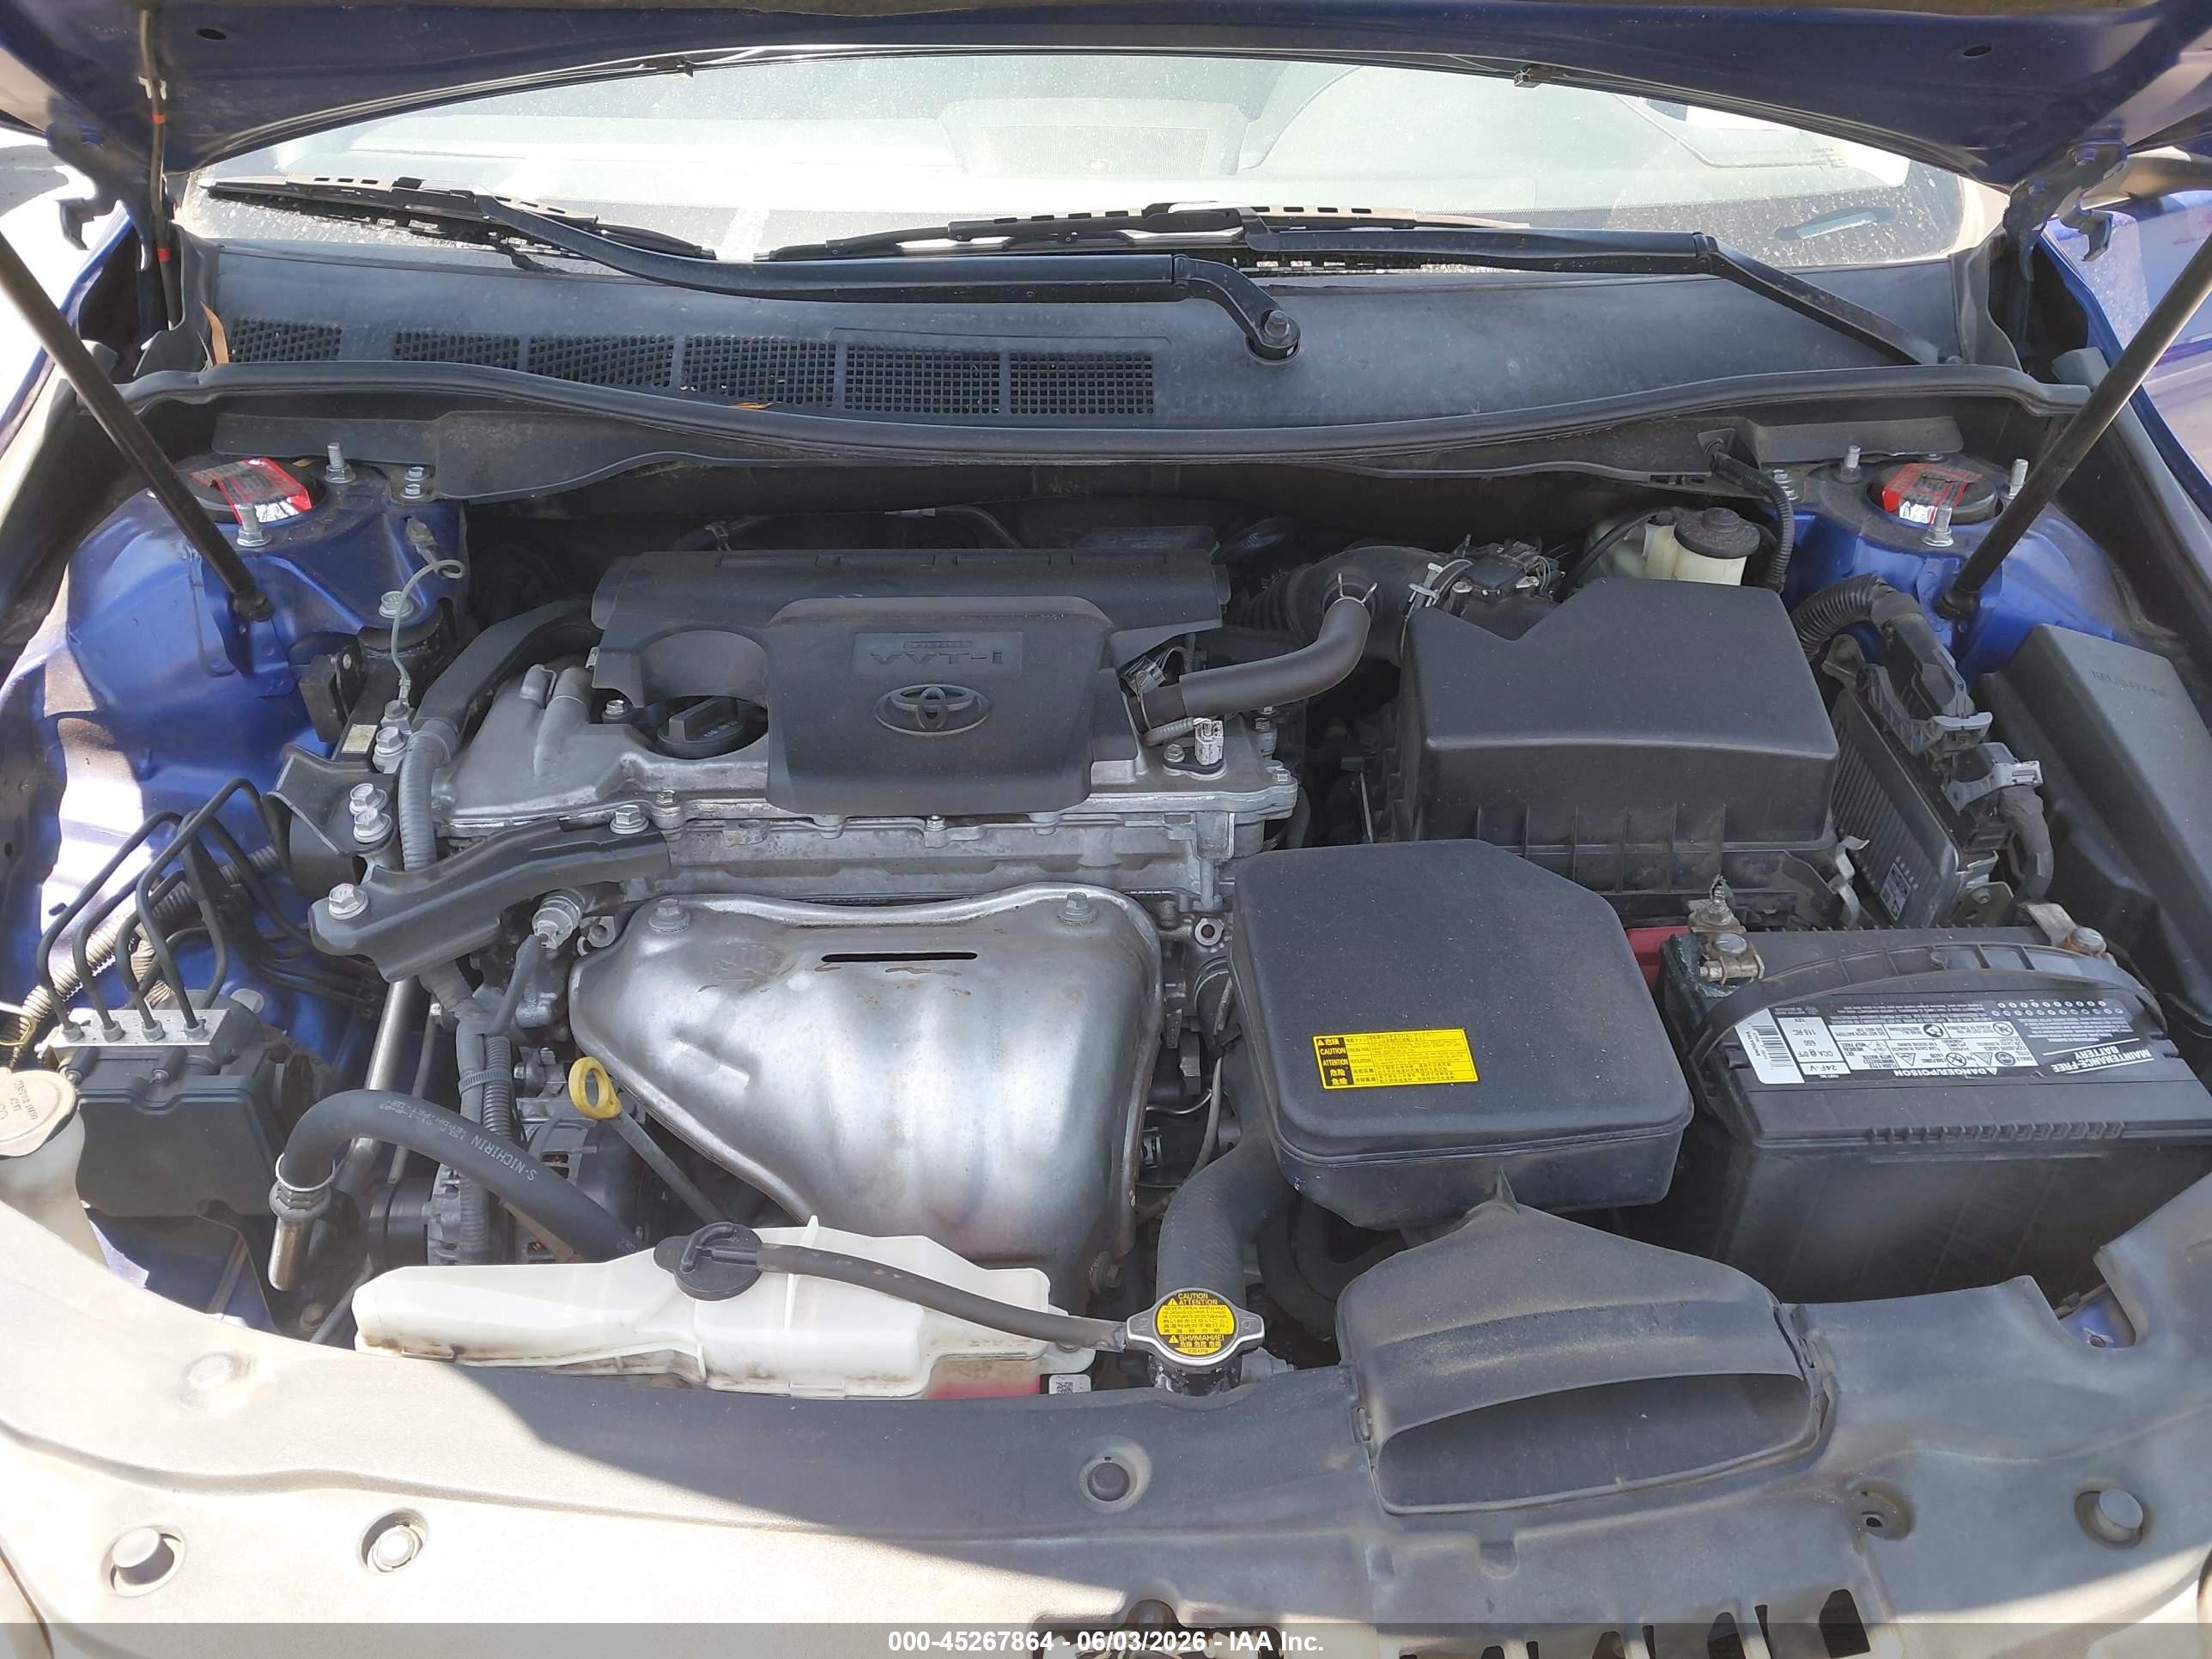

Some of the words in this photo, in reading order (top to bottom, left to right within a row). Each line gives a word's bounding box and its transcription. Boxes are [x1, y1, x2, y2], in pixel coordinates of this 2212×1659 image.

[2074, 1045, 2120, 1060] BATTERY
[2050, 1048, 2152, 1073] MAINTENANCE-FREE
[1894, 1067, 1987, 1077] DANGER/POISON
